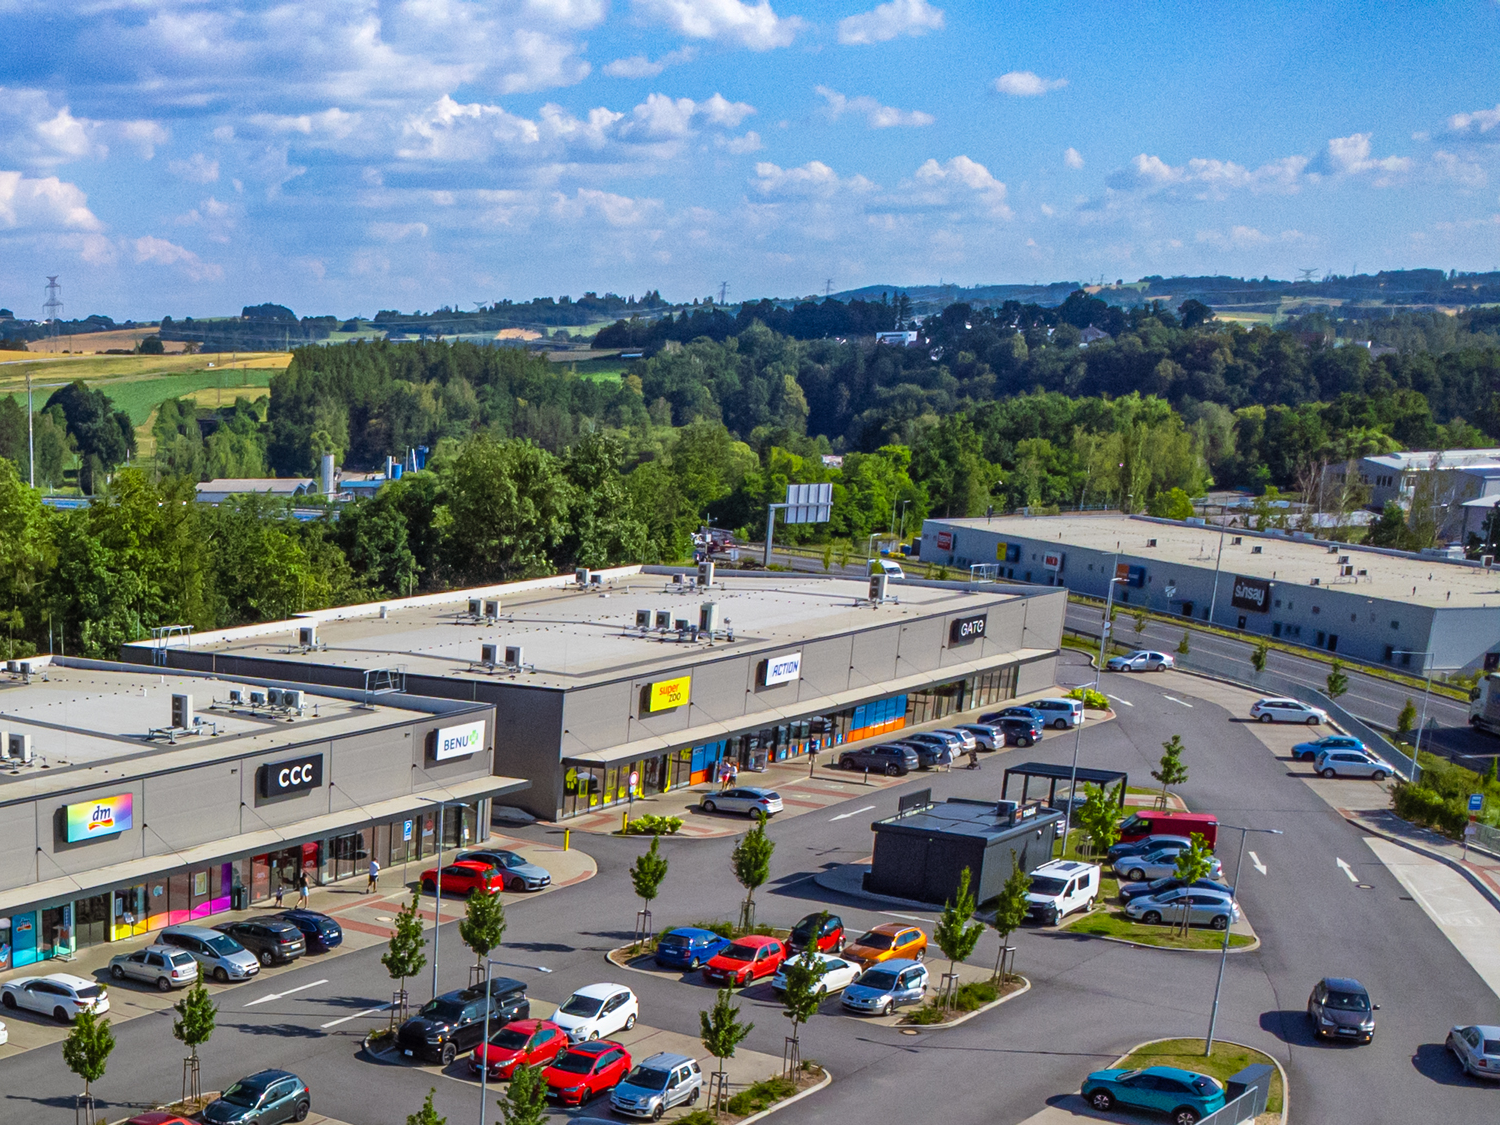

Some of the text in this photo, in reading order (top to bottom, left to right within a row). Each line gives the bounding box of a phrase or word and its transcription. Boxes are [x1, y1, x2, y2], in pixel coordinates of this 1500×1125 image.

[772, 660, 799, 677] ACTION
[659, 683, 679, 696] super
[443, 734, 469, 751] BENU
[278, 763, 313, 788] CCC
[92, 805, 111, 821] dm
